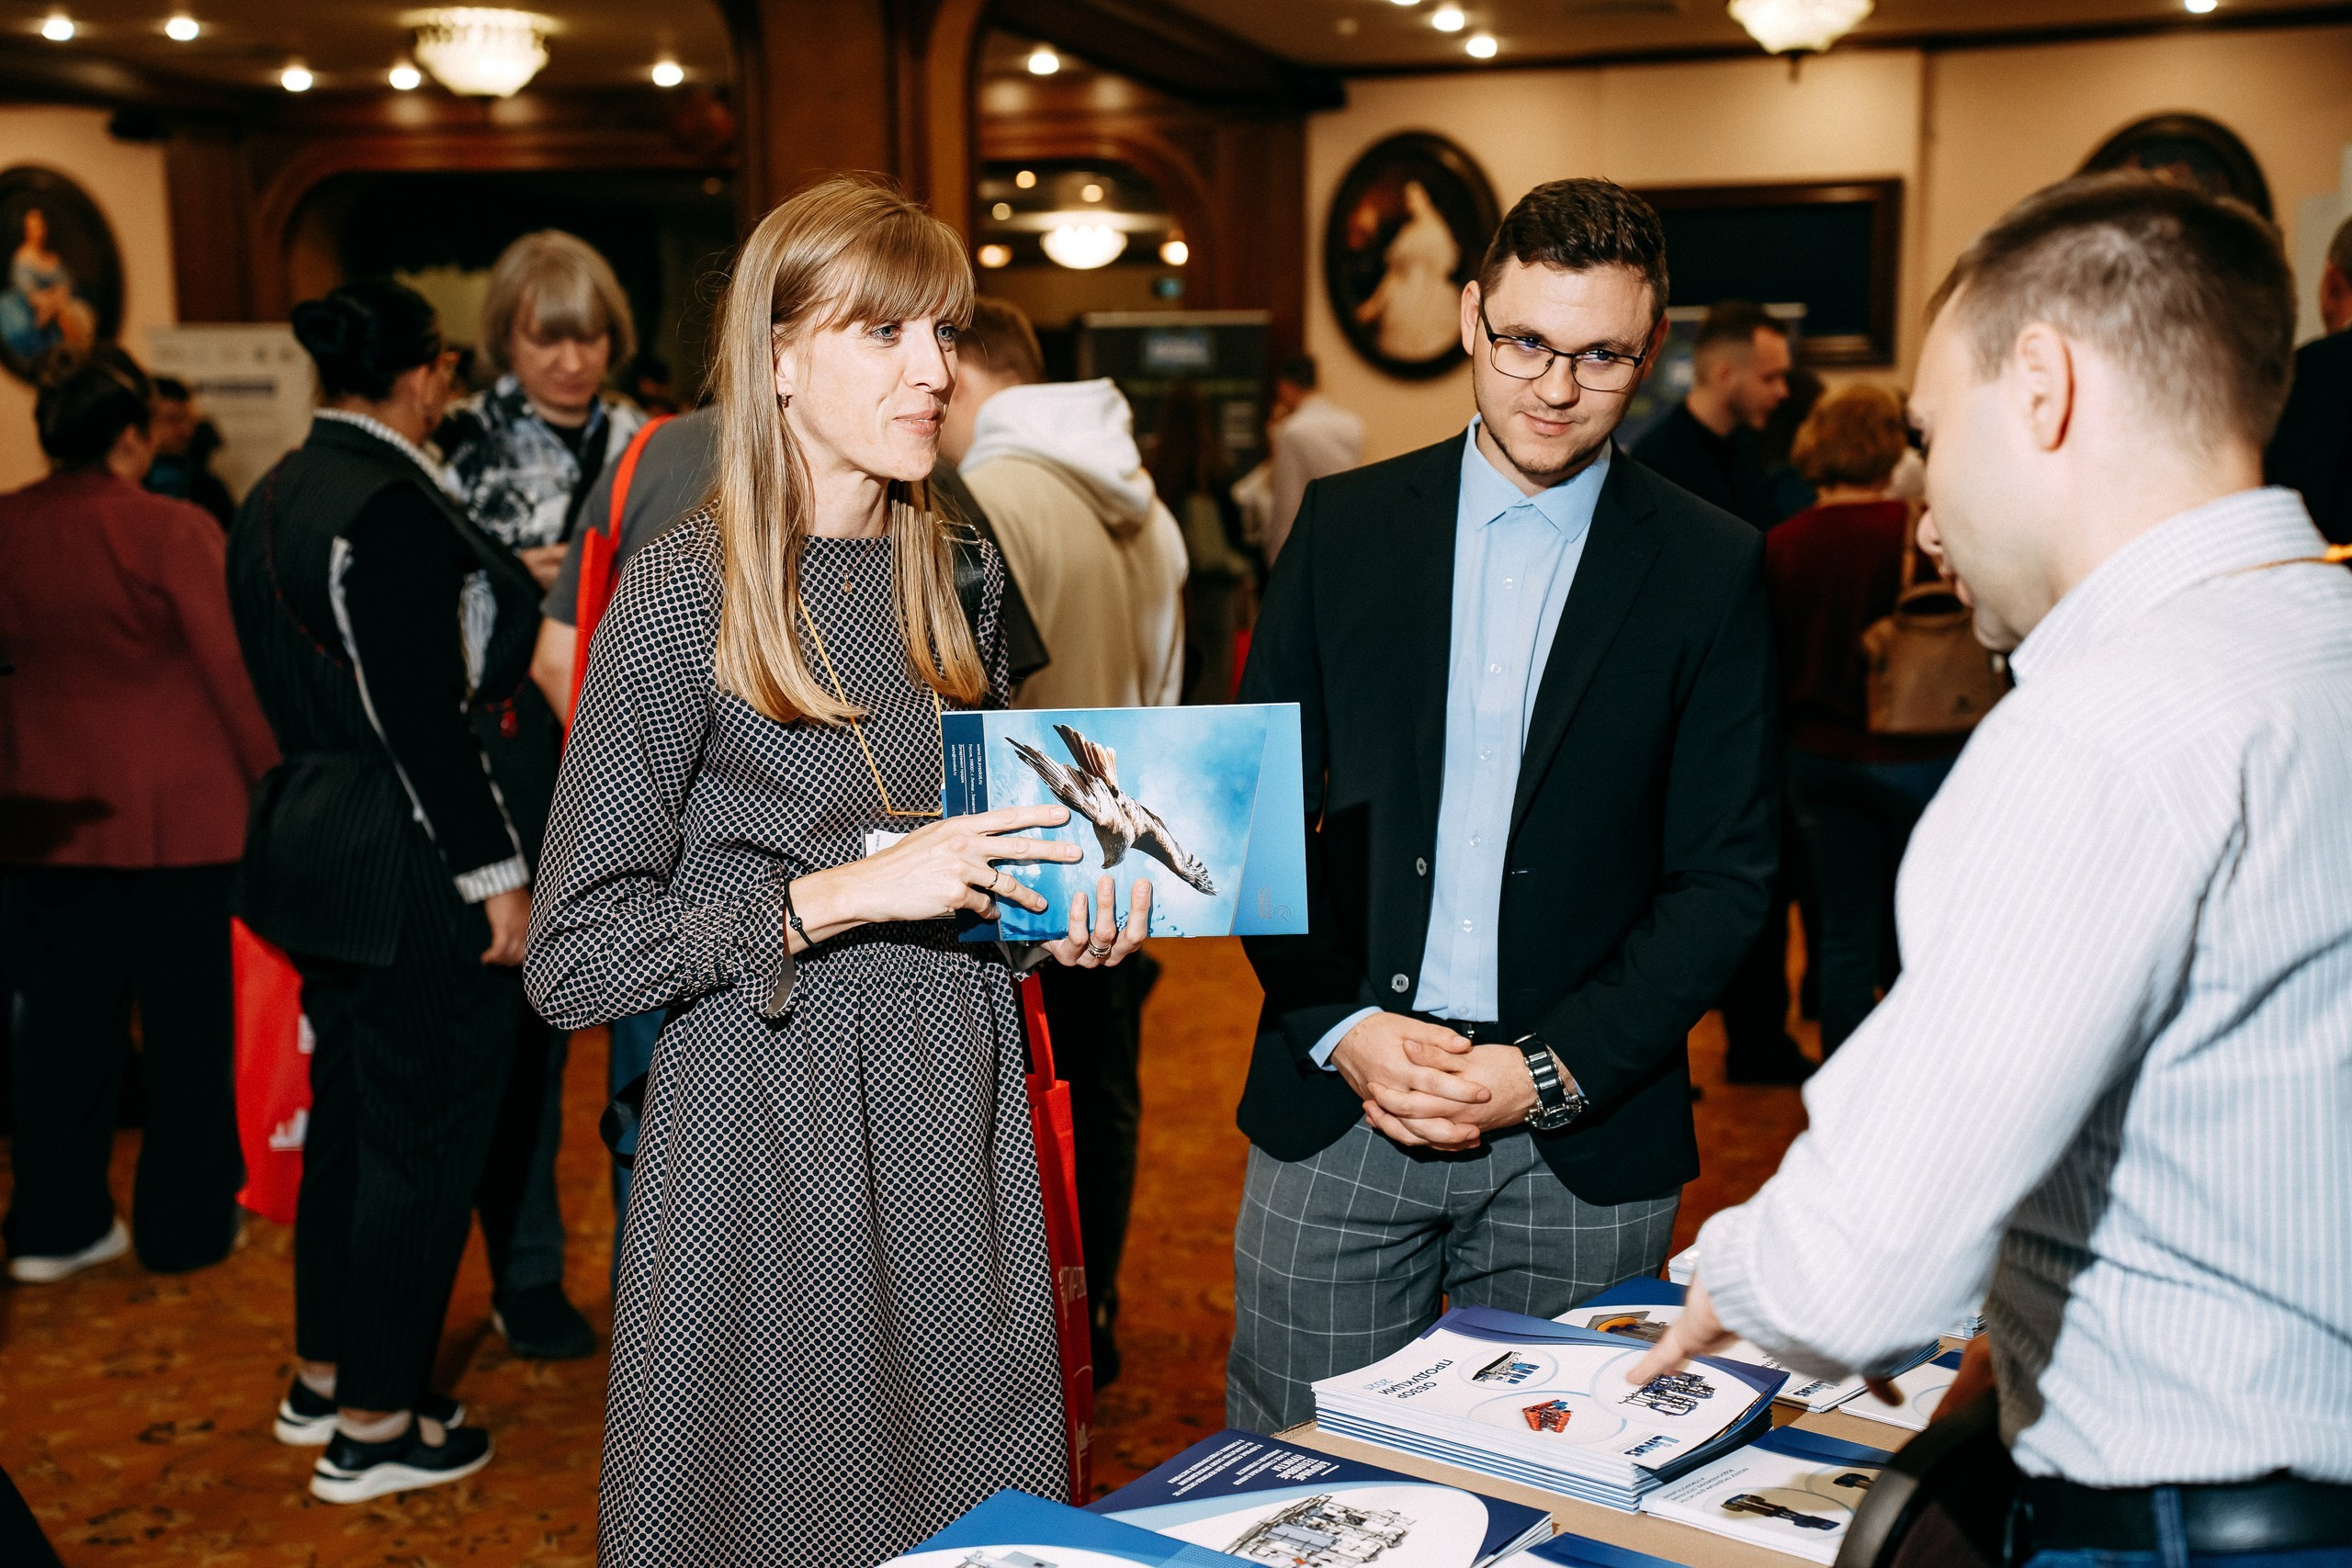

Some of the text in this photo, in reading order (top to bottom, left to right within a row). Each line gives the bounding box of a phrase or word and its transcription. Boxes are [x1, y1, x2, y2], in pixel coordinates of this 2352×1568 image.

[1363, 1378, 1394, 1391] 2025
[1378, 1359, 1454, 1395] ПРОДУКЦИИ
[1396, 1382, 1437, 1399] ОБЗОР
